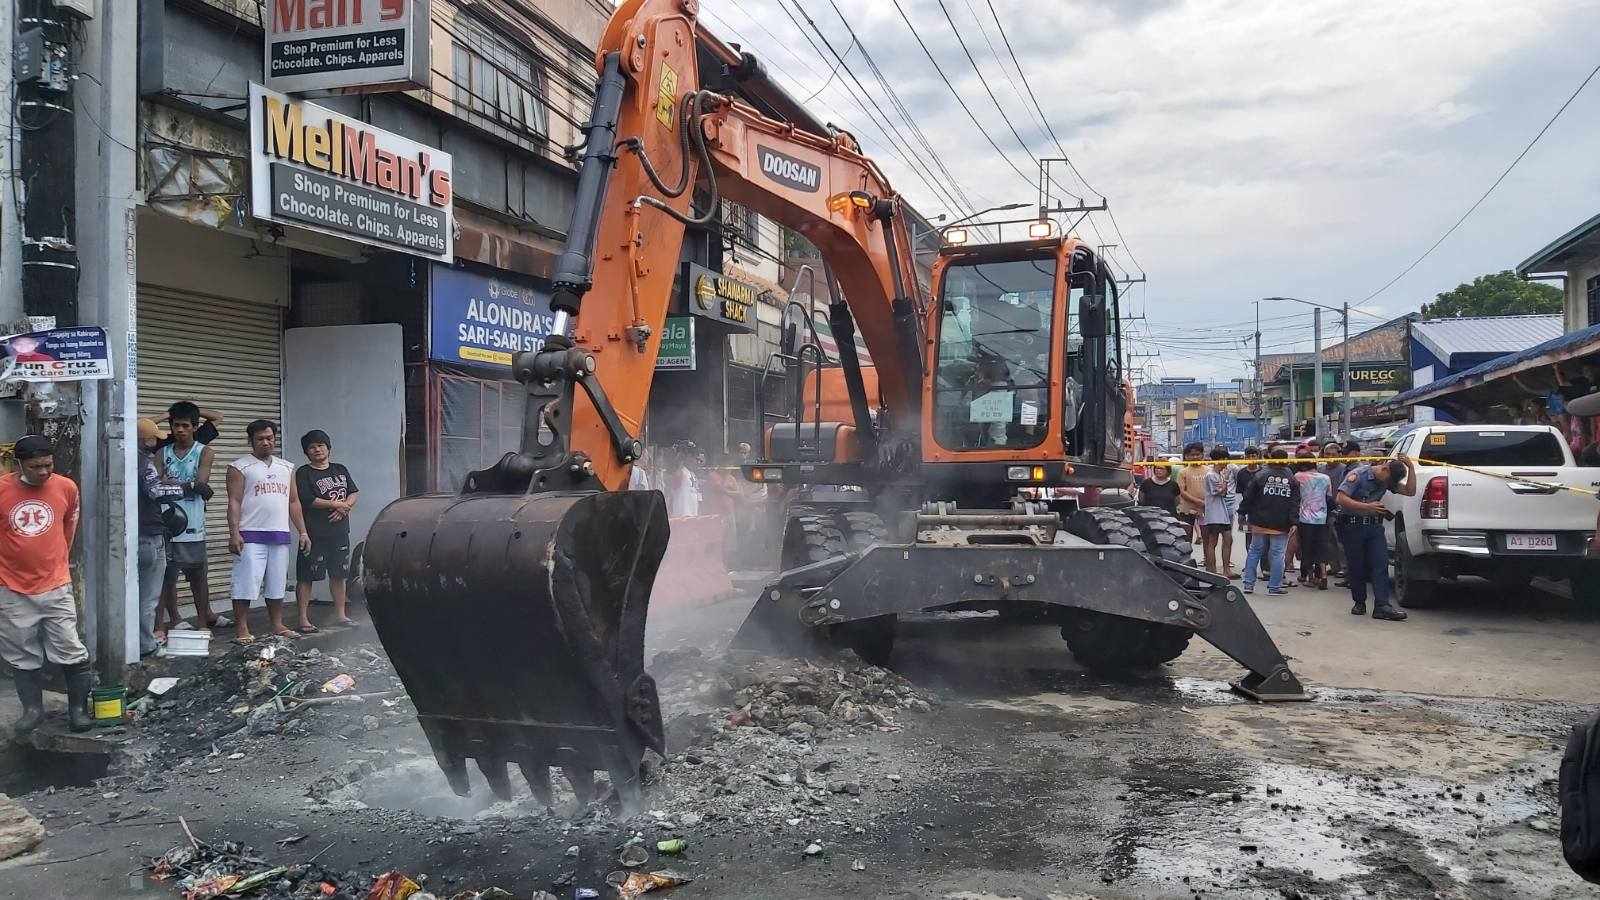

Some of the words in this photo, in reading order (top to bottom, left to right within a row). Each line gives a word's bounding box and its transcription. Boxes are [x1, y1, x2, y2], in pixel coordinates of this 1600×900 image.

[272, 57, 323, 70] Chocolate.
[325, 54, 356, 66] Chips.
[359, 49, 404, 64] Apparels
[283, 44, 308, 56] Shop
[310, 40, 354, 53] Premium
[356, 37, 371, 49] for
[373, 36, 397, 47] Less
[262, 95, 451, 207] MelMan's
[763, 152, 817, 188] DOOSAN
[294, 173, 331, 202] Shop
[334, 184, 391, 216] Premium
[394, 203, 411, 221] for
[413, 207, 439, 229] Less
[279, 192, 353, 227] Chocolate.
[356, 213, 394, 238] Chips.
[397, 224, 446, 250] Apparels
[466, 298, 553, 336] ALONDRA'S
[458, 323, 522, 352] SARI-SARI
[52, 361, 97, 369] Cruz
[1263, 487, 1292, 498] POLICE
